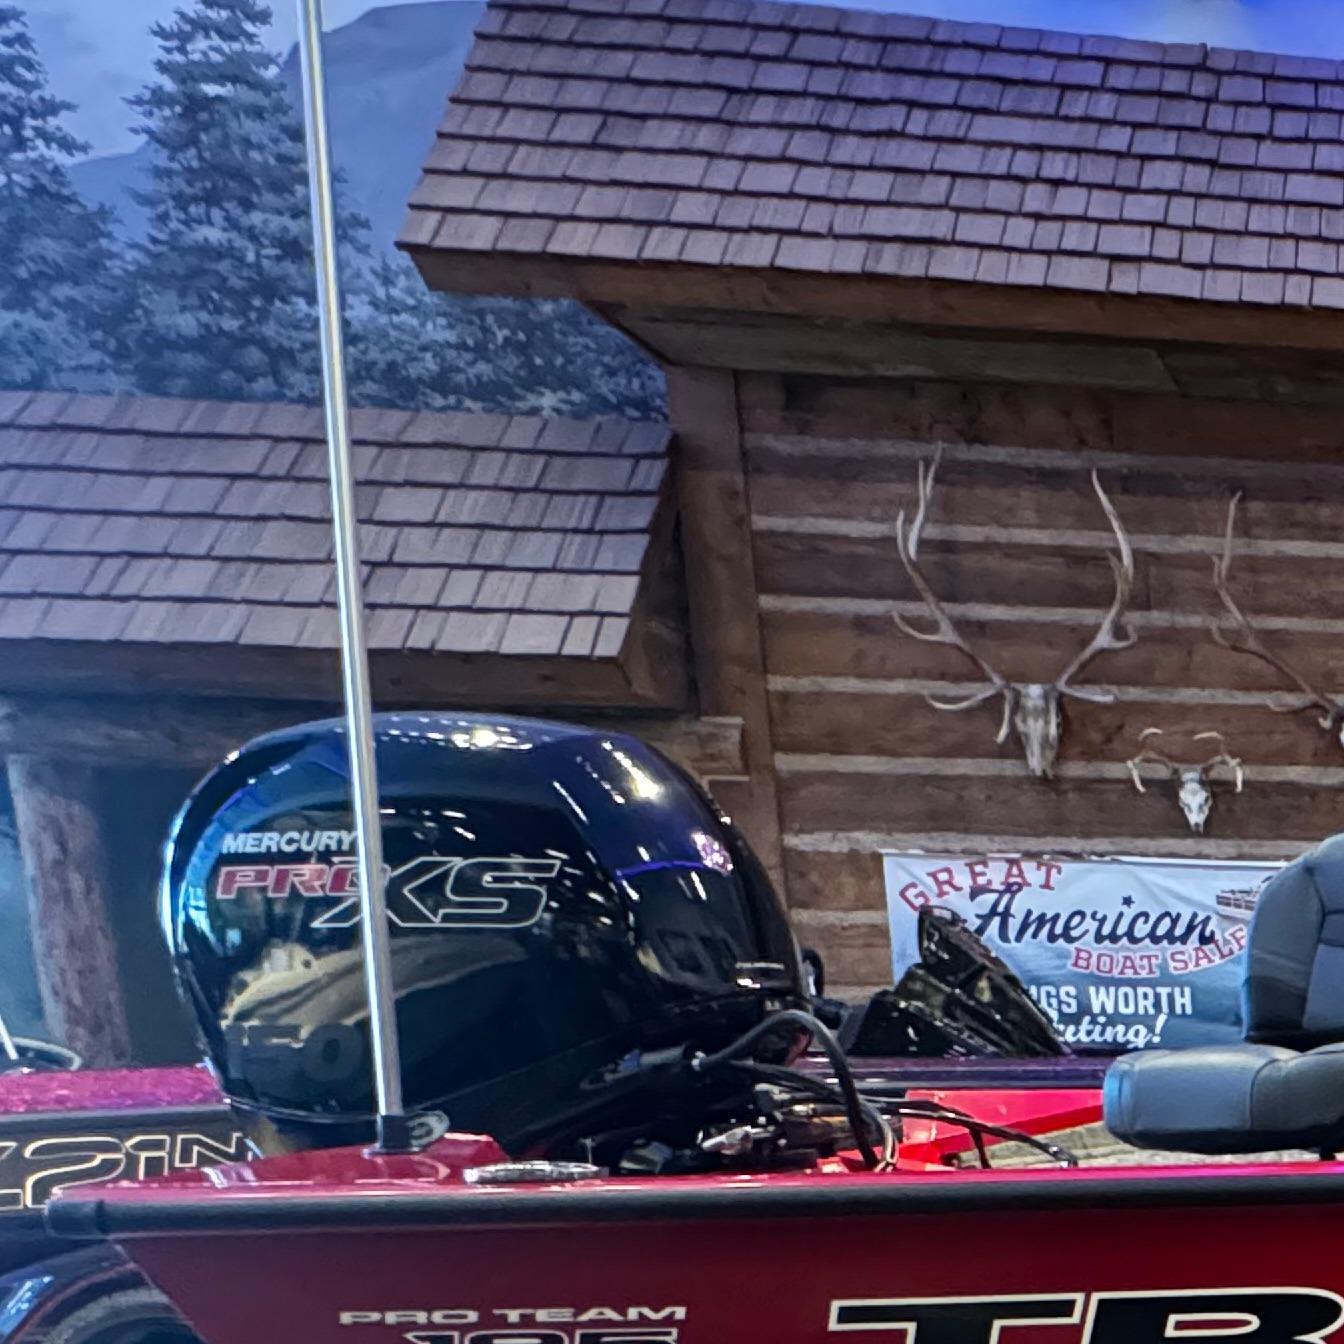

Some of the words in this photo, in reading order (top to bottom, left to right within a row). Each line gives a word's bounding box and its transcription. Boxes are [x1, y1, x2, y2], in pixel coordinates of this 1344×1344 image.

[222, 830, 360, 854] MERCURY
[899, 859, 1063, 912] GREAT
[969, 881, 1216, 946] American
[1072, 946, 1159, 977] BOAT
[1088, 985, 1193, 1015] WORTH
[339, 1309, 480, 1326] PRO
[492, 1305, 688, 1324] TEAM
